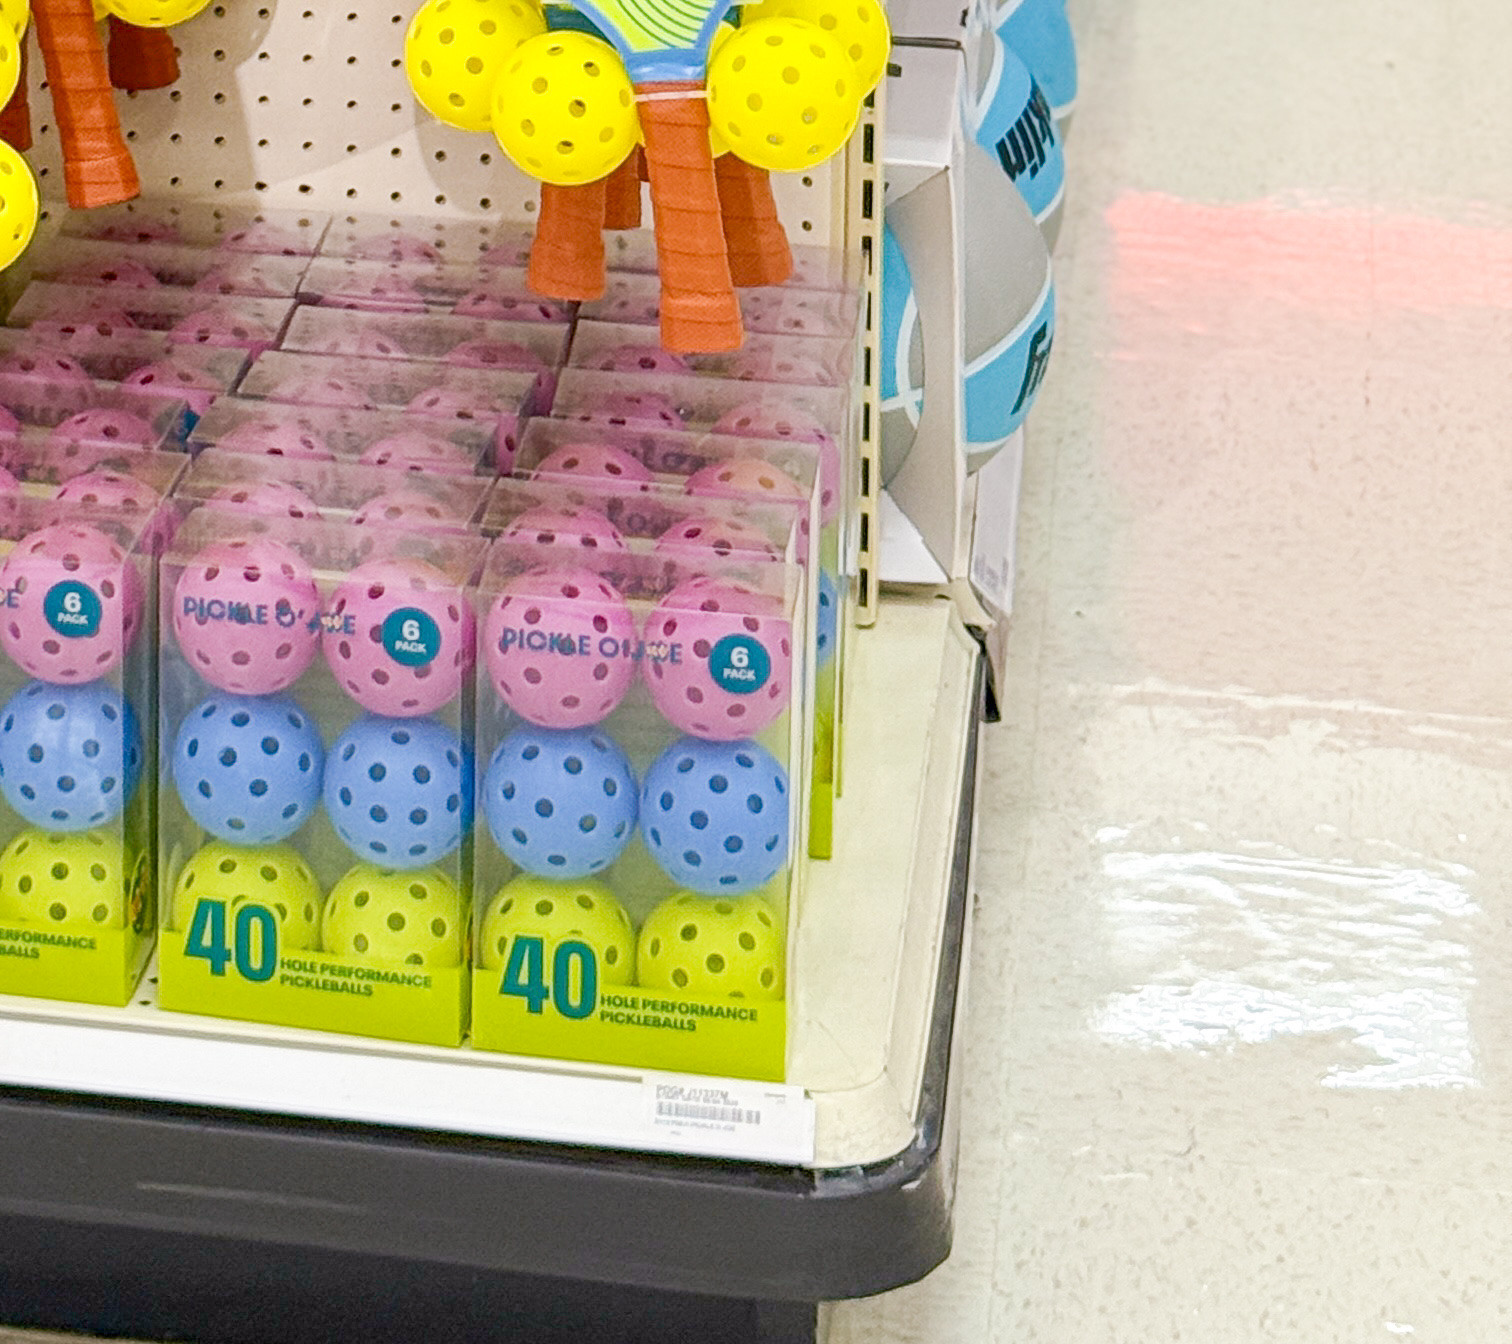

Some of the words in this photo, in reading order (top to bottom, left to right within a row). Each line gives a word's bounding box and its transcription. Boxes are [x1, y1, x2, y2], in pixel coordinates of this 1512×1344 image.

[63, 592, 82, 613] 6
[57, 613, 89, 625] PACK
[402, 619, 421, 641] 6
[395, 641, 427, 654] PACK
[730, 646, 750, 668] 6
[723, 668, 756, 682] PACK
[184, 897, 277, 982] 40
[279, 957, 318, 974] HOLE
[320, 963, 433, 988] PERFORMANCE
[499, 934, 597, 1020] 40
[280, 975, 374, 997] PICKLEBALLS
[600, 993, 640, 1010] HOLE
[642, 997, 758, 1022] PERFORMANCE
[600, 1010, 697, 1032] PICKLEBALLS
